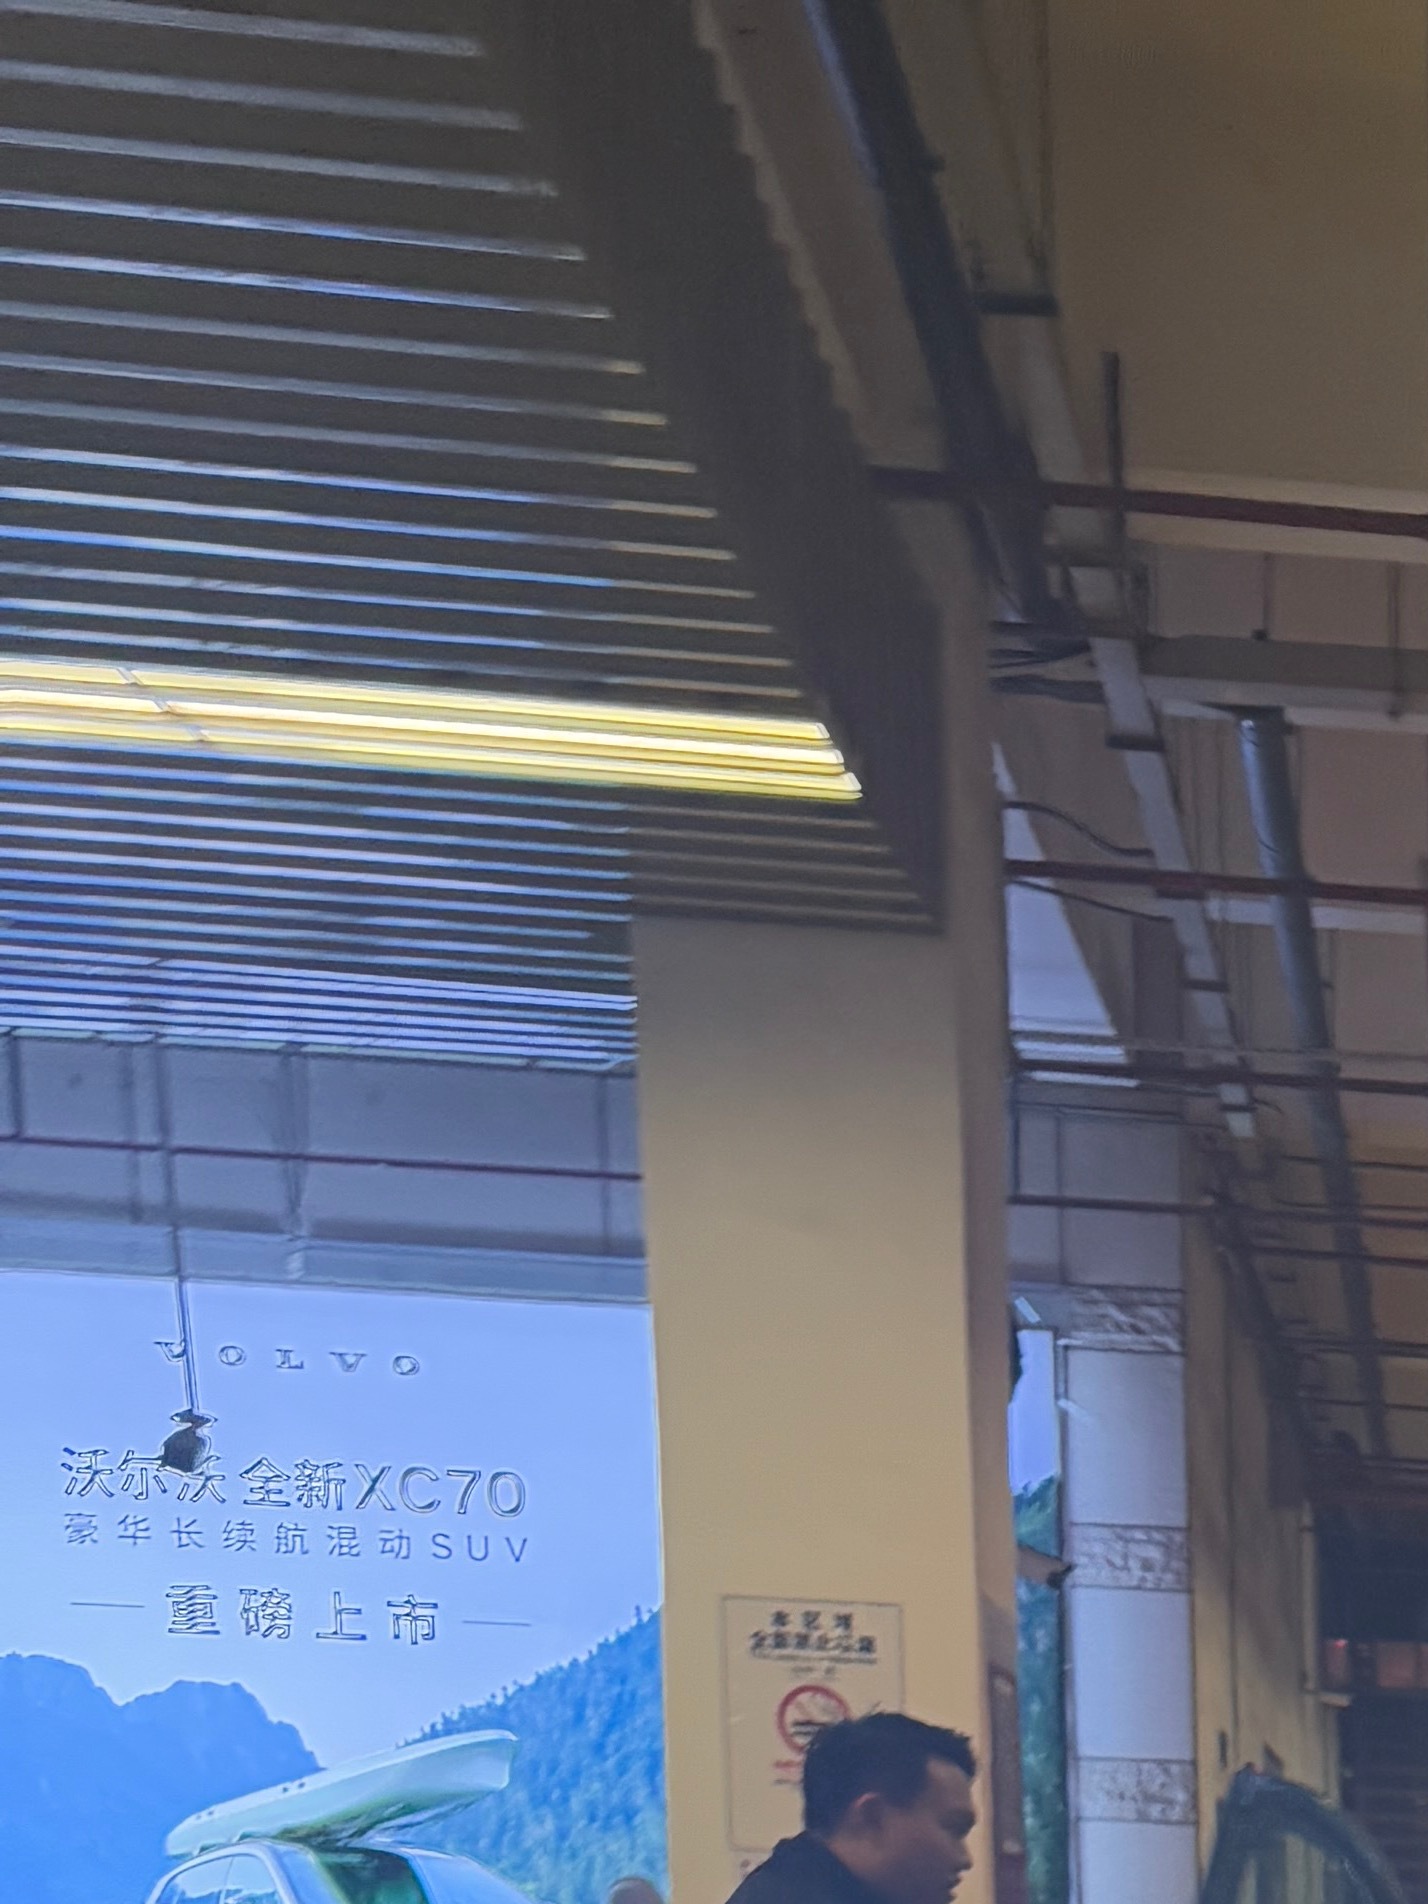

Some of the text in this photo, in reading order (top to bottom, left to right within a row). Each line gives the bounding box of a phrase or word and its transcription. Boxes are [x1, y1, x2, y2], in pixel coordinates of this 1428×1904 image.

[63, 1512, 528, 1563] 豪华长续航混动SUV
[165, 1584, 438, 1645] 重磅上市
